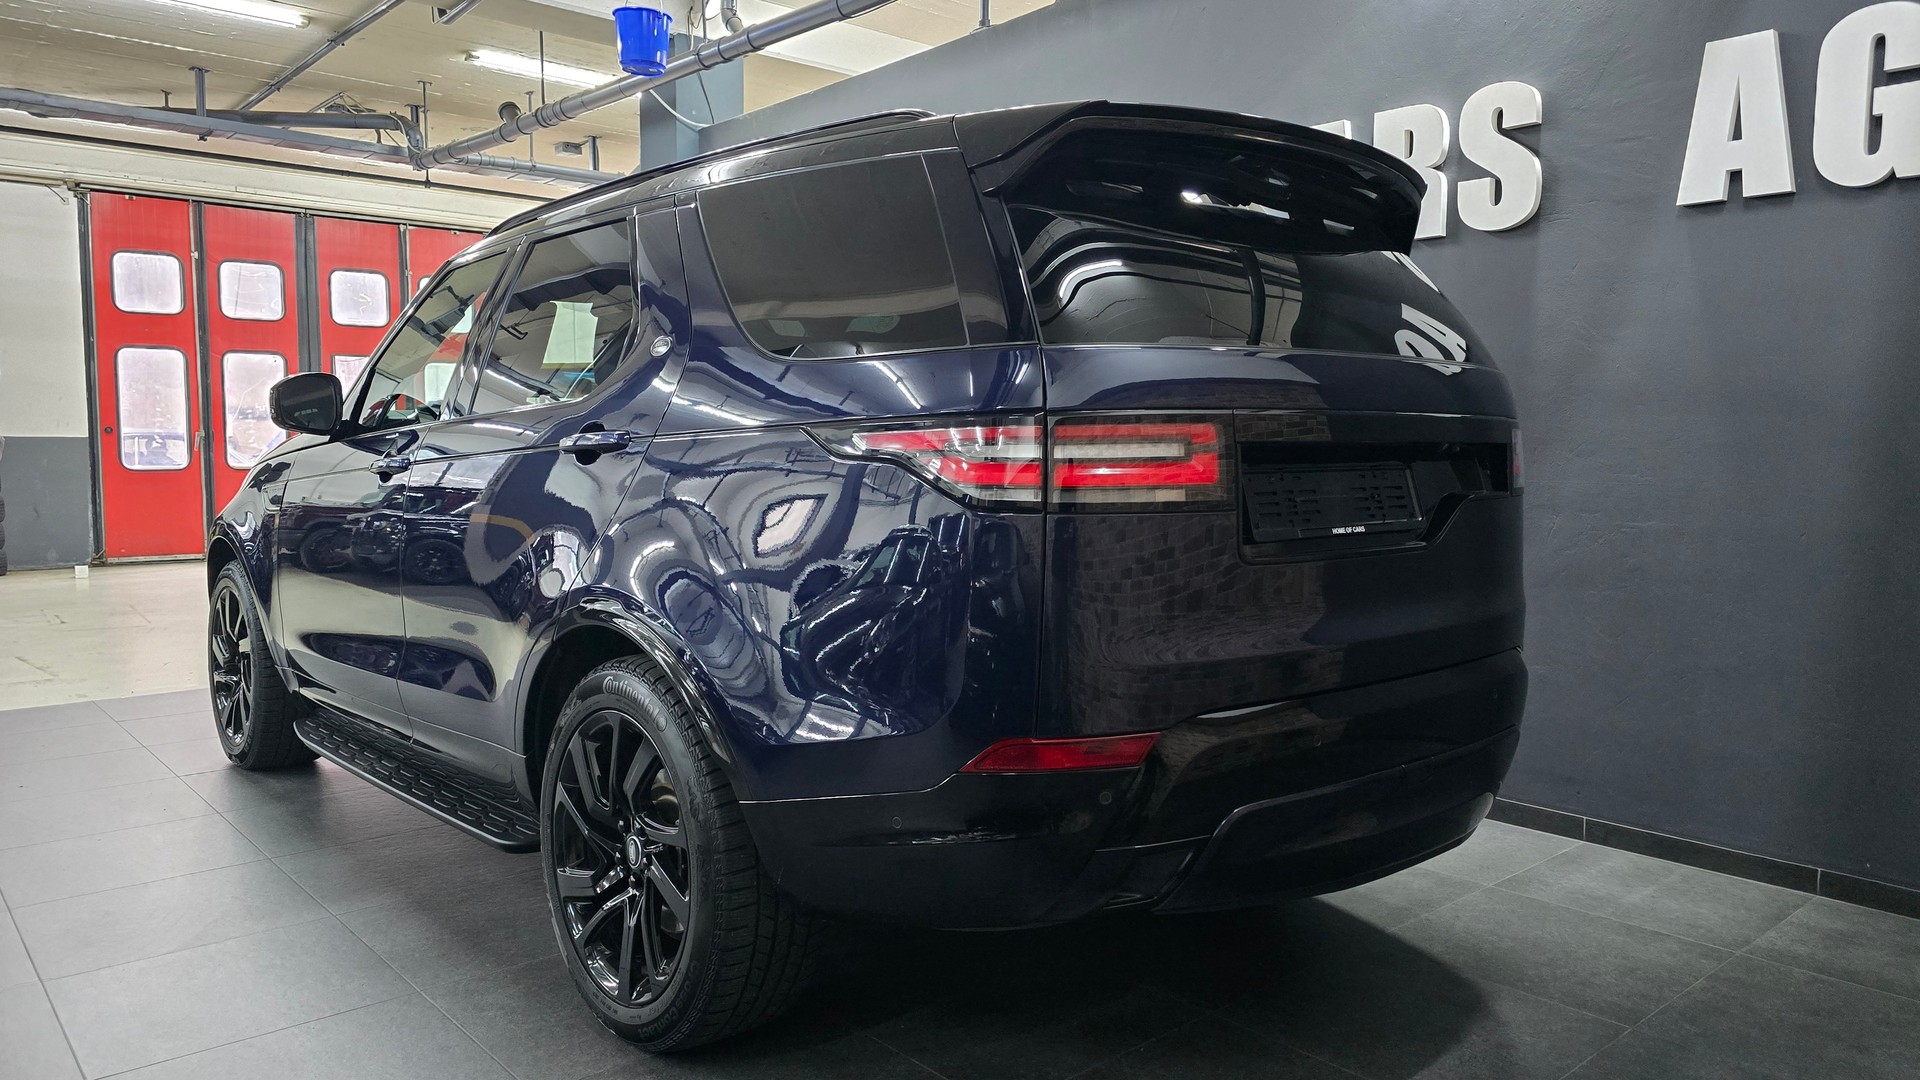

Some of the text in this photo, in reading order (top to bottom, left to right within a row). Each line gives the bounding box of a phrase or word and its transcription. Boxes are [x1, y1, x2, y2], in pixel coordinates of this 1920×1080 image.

[1311, 0, 1920, 239] RS AG
[1352, 525, 1365, 533] CARS
[602, 675, 660, 722] Continental
